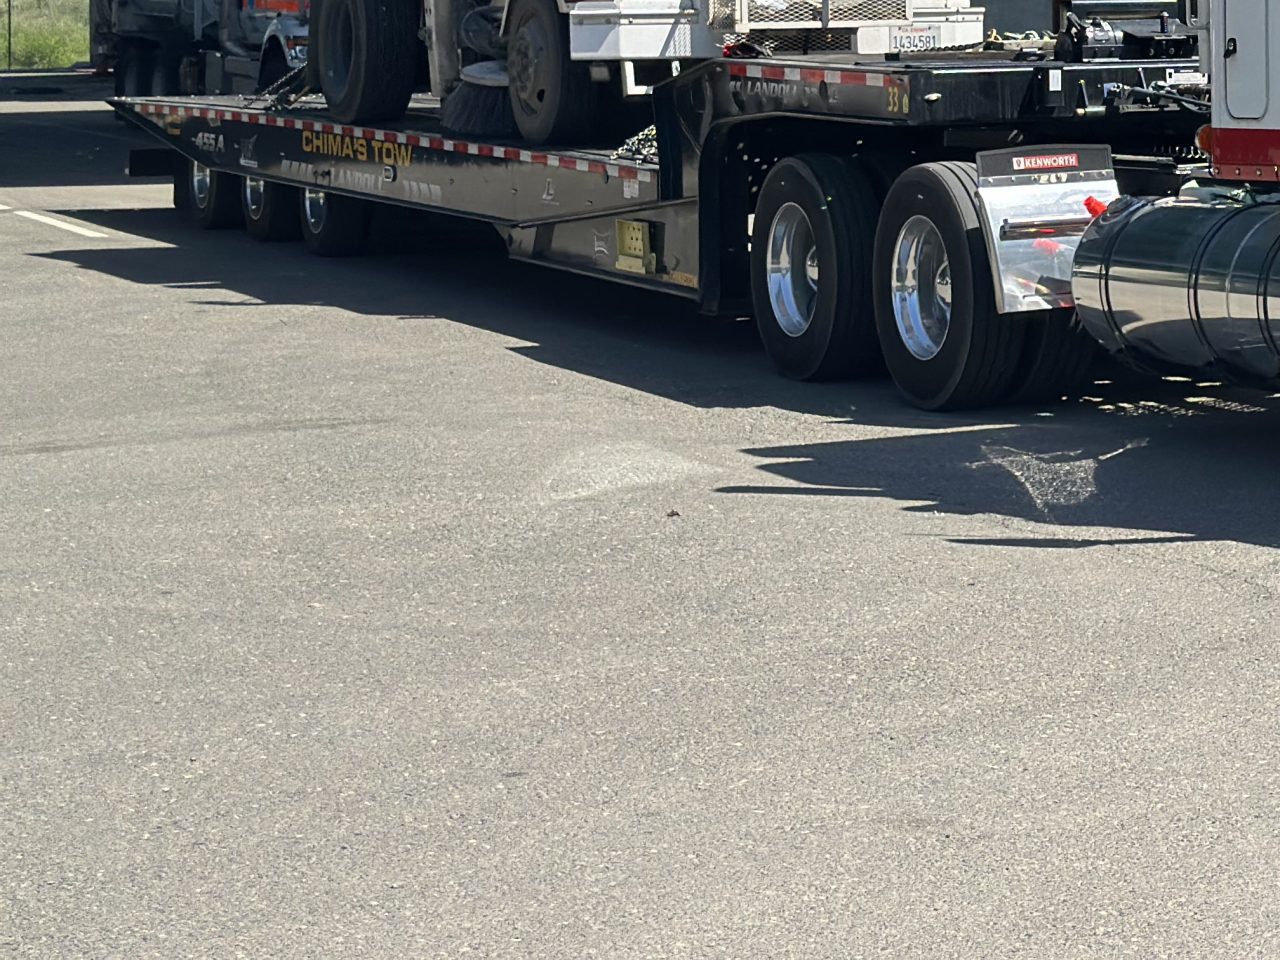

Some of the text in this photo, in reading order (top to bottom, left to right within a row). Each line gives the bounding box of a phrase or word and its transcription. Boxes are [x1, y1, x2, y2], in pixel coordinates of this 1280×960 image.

[893, 35, 937, 49] 1434581
[302, 130, 413, 167] CHIMA'S TOW
[1024, 155, 1076, 168] KENWORTH
